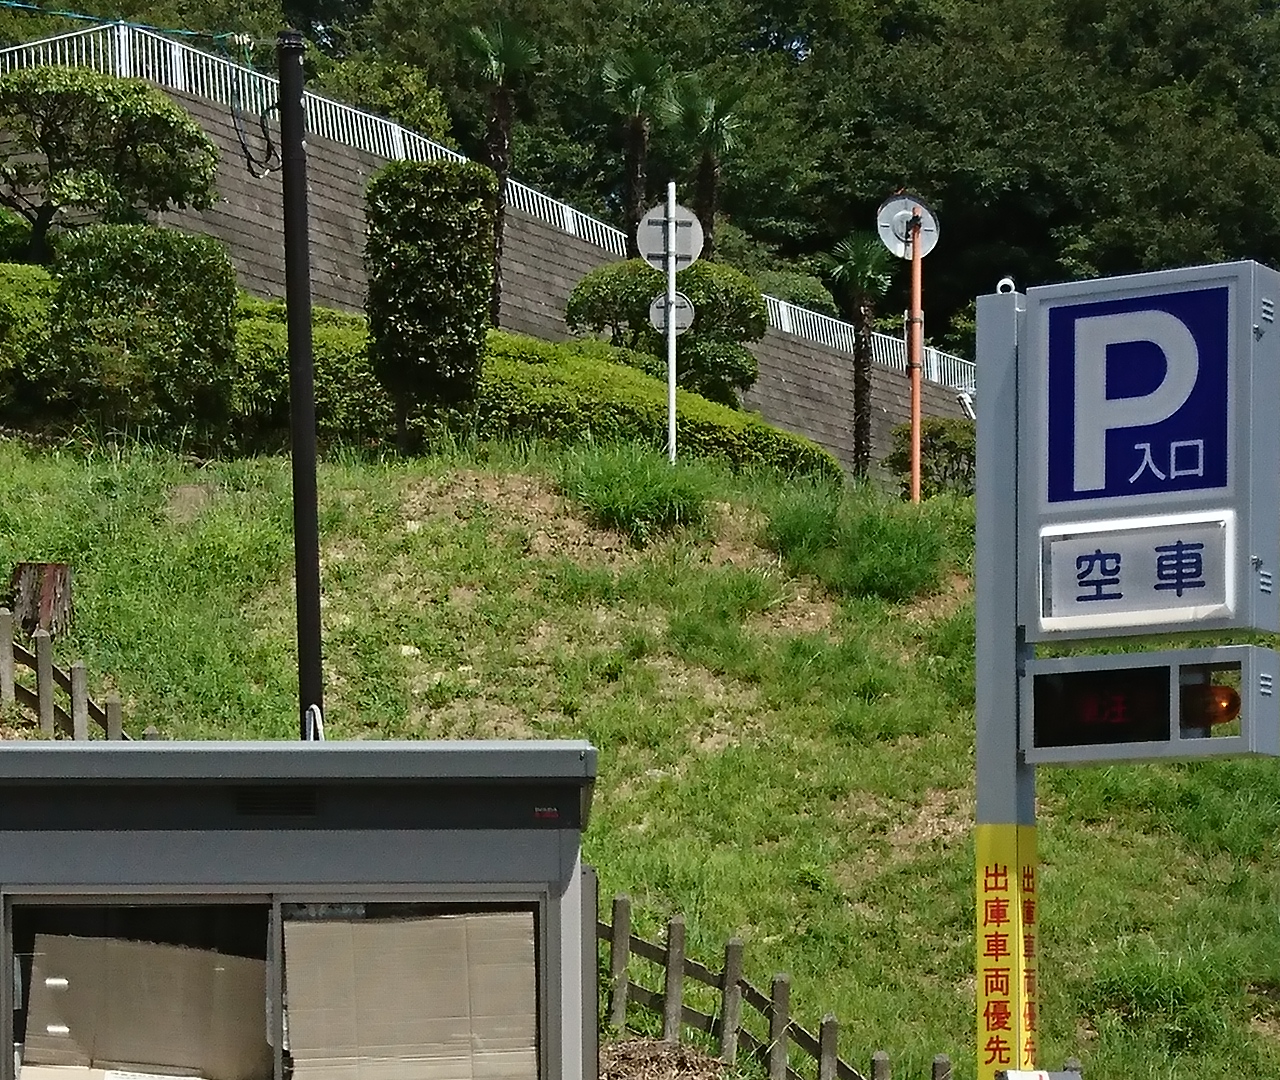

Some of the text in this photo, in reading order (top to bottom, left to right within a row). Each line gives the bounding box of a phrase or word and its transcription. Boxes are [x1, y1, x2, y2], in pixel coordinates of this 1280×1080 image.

[1073, 309, 1199, 492] P
[1128, 439, 1205, 483] 入口
[1075, 540, 1206, 602] 空車
